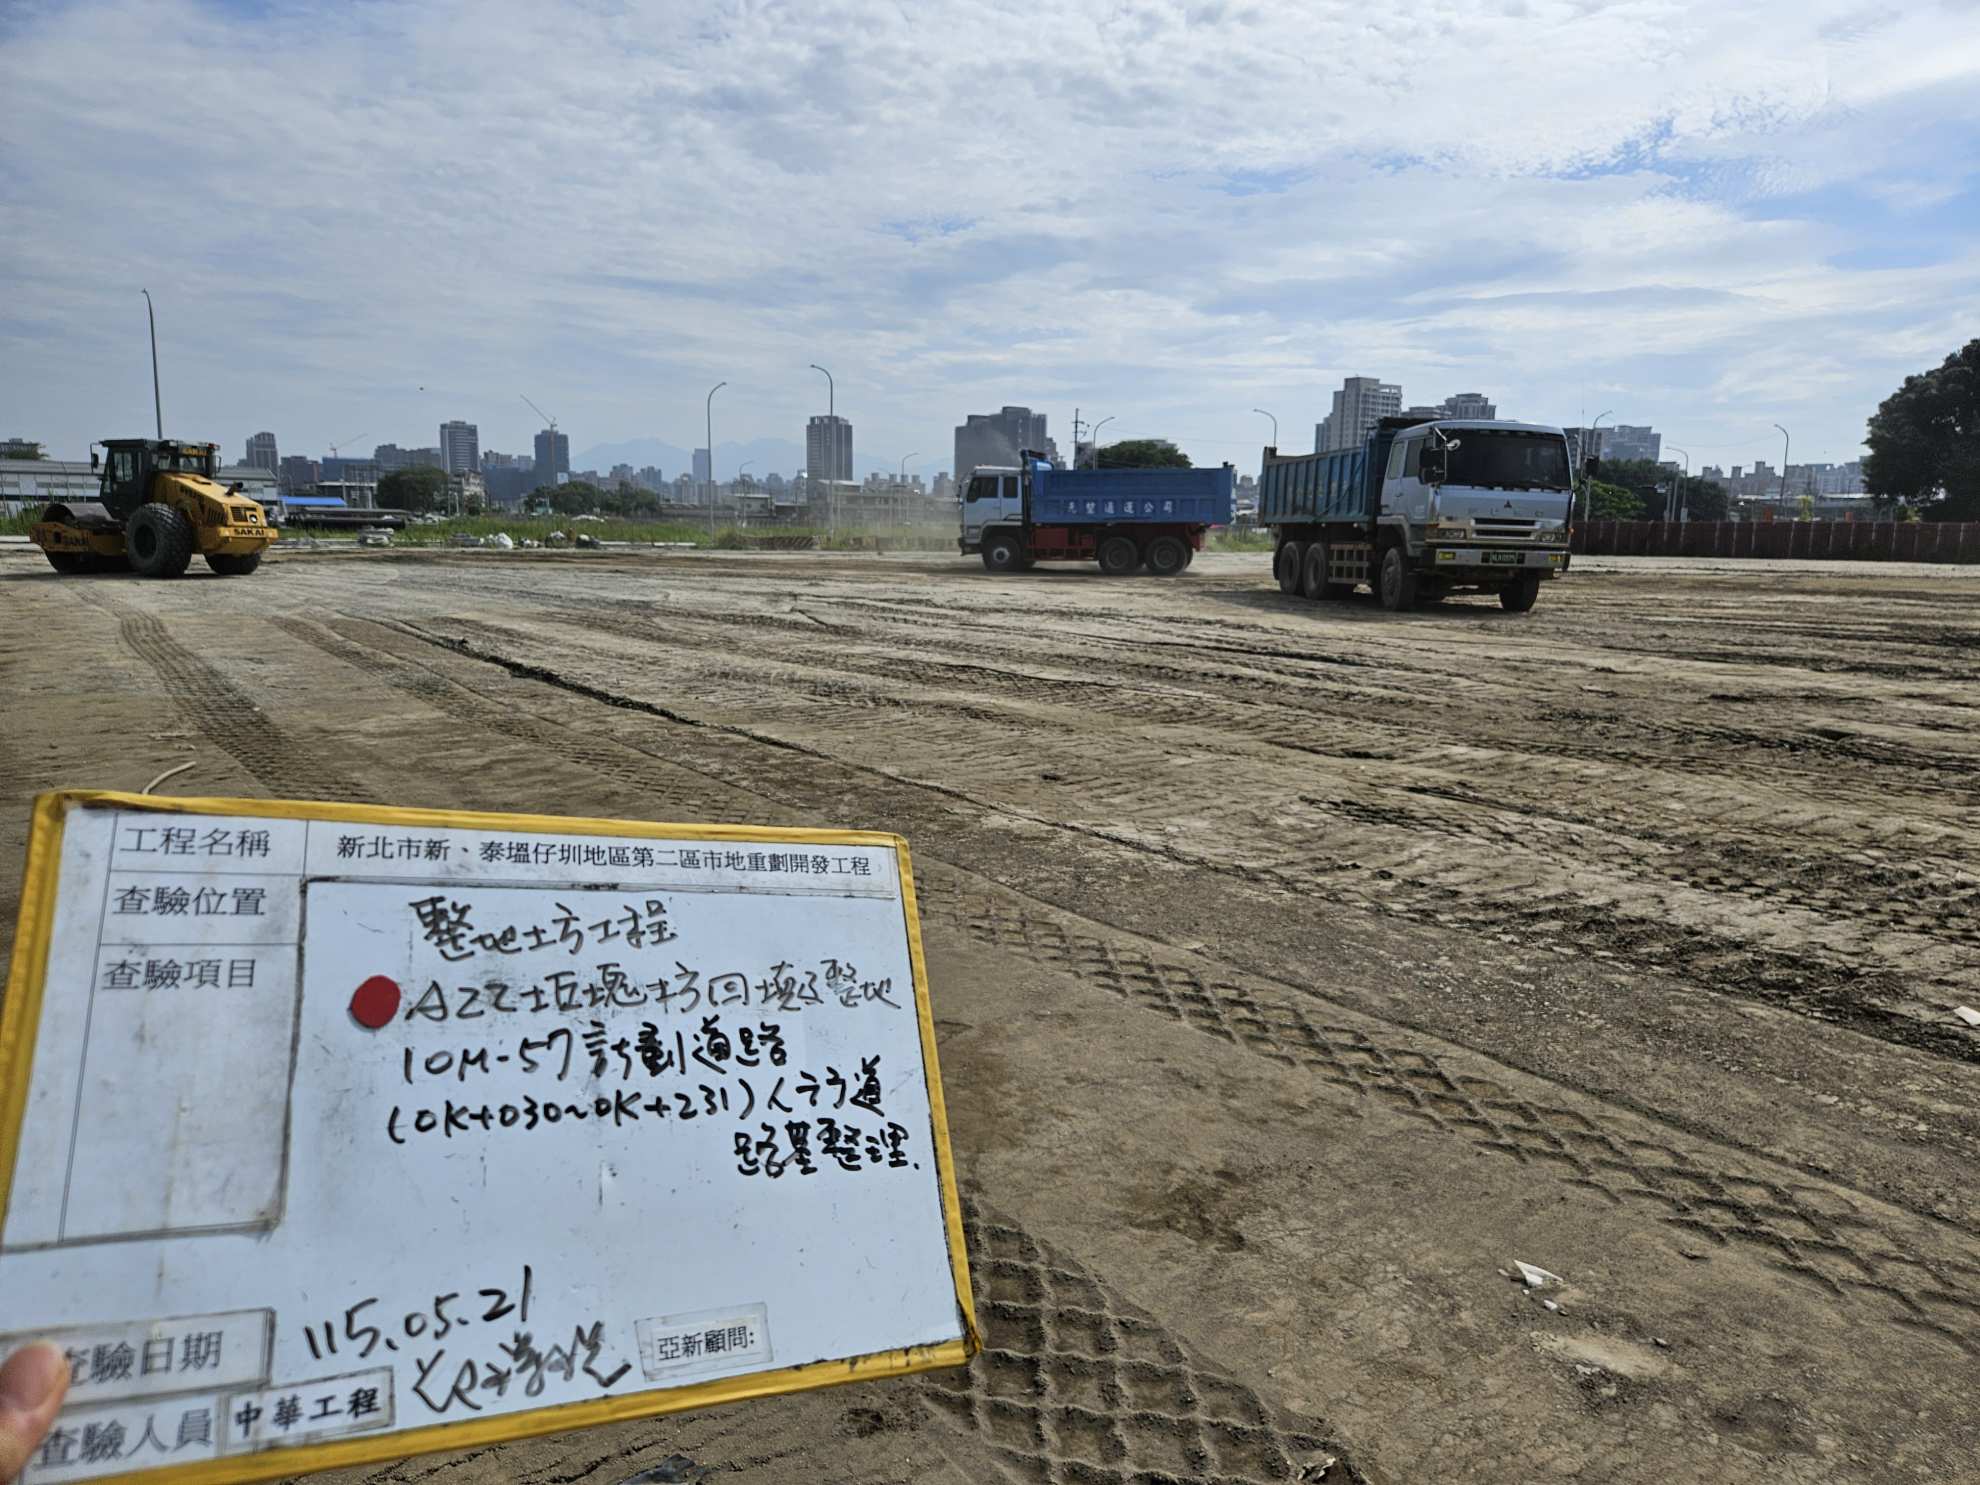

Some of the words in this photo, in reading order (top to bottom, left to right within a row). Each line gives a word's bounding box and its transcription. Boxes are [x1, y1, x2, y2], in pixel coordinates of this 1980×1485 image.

[233, 527, 265, 536] SAKAI
[119, 826, 271, 857] 工程名稱
[336, 834, 873, 876] 新北市新、泰塭仔圳地區第二區市地重劃開發工程
[112, 885, 267, 917] 查驗位置
[408, 896, 679, 961] 整地土方工程
[101, 958, 256, 991] 查驗項目
[304, 1264, 533, 1359] 115.05.21
[657, 1325, 756, 1361] 亞新顧問:
[234, 1386, 382, 1438] 中華工程
[32, 1407, 214, 1472] 查驗人員
